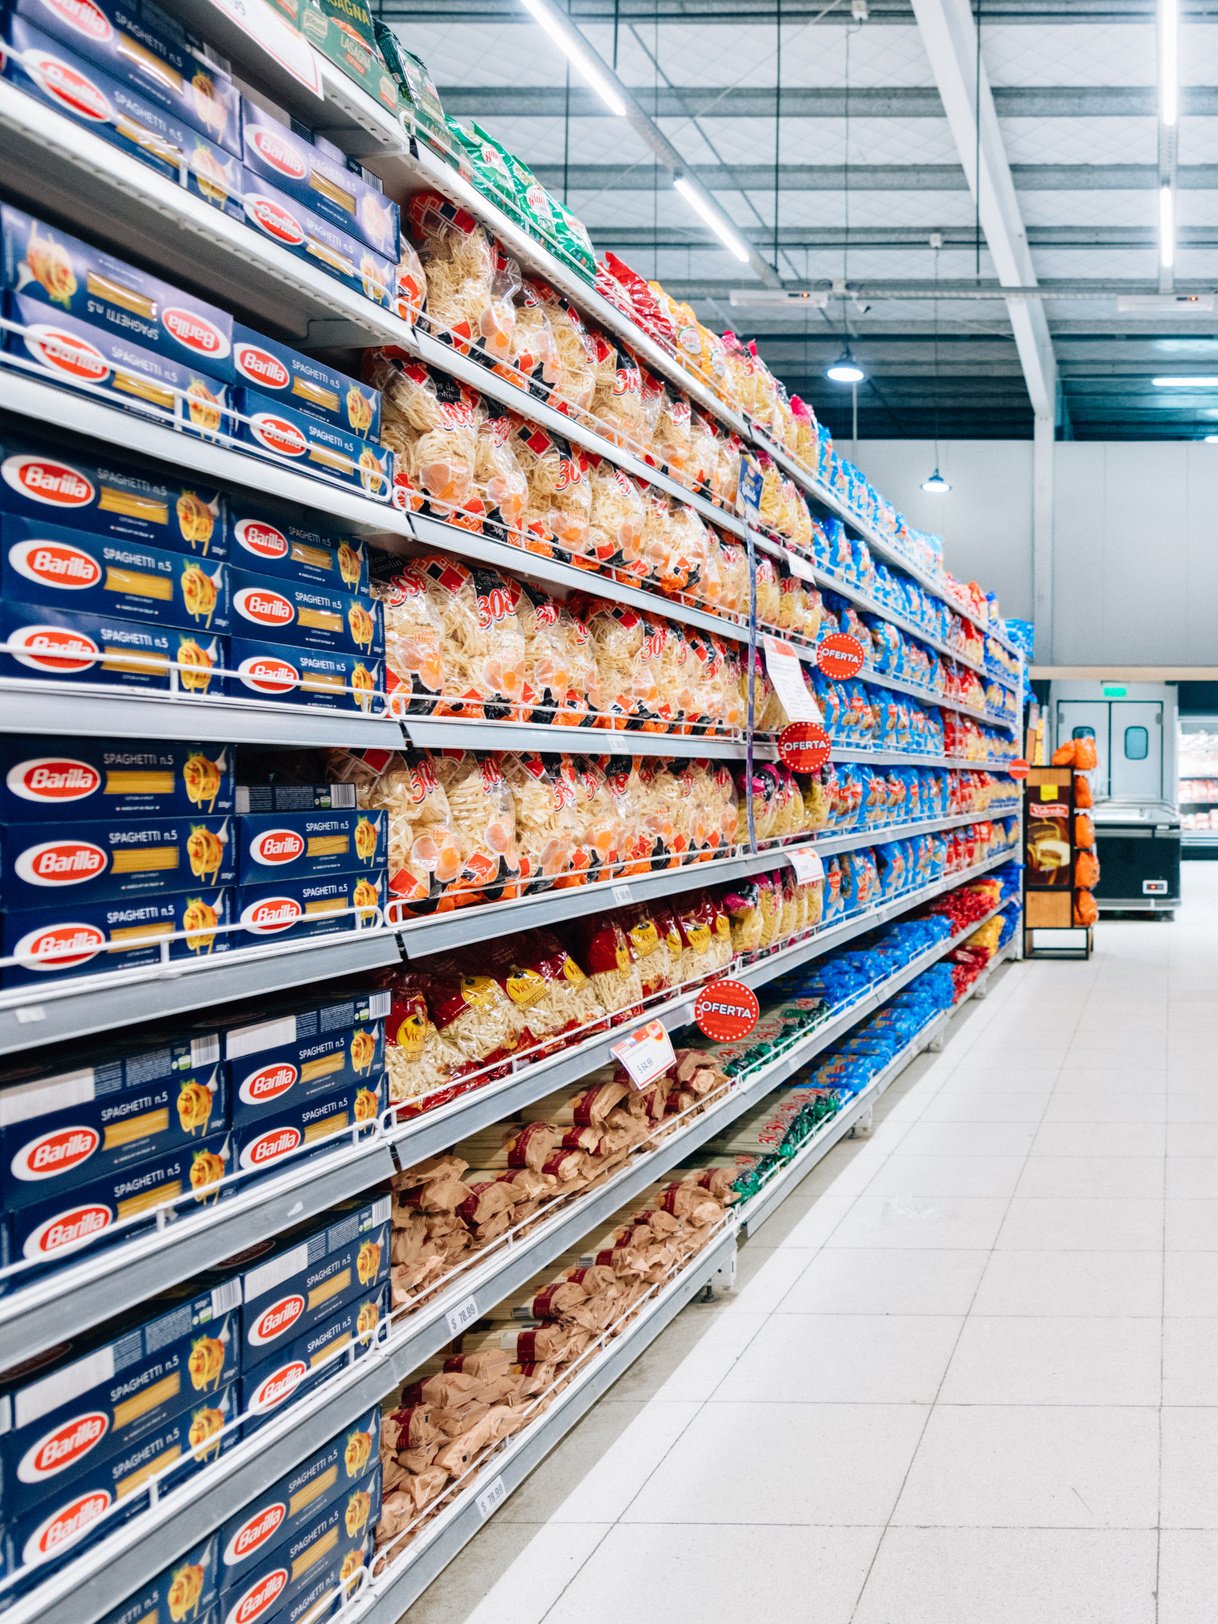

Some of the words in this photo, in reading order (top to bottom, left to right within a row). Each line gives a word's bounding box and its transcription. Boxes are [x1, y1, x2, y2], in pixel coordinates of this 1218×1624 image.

[169, 52, 183, 67] n.5
[168, 126, 183, 142] n.5
[259, 136, 302, 178] Barilla
[343, 241, 354, 254] n.5
[87, 300, 104, 313] n.5
[167, 313, 217, 348] Barilla
[111, 345, 163, 377] SPAGHETTI
[164, 370, 178, 383] n.5
[244, 353, 285, 384] Barilla
[292, 358, 329, 384] SPAGHETTI
[329, 376, 340, 389] n.5
[309, 426, 343, 448] SPAGHETTI
[344, 440, 354, 452] n.5
[24, 465, 87, 499] Barilla
[97, 468, 151, 493] SPAGHETTI
[152, 485, 168, 497] n.5
[249, 531, 285, 552] Barilla
[288, 526, 322, 545] SPAGHETTI
[322, 536, 332, 547] n.5
[32, 550, 95, 581] Barilla
[103, 548, 156, 570] SPAGHETTI
[158, 560, 172, 573] n.5
[249, 598, 290, 620] Barilla
[294, 591, 331, 607] SPAGHETTI
[332, 598, 343, 609] n.5
[101, 628, 152, 646] SPAGHETTI
[154, 637, 169, 649] n.5
[300, 657, 334, 671] SPAGHETTI
[335, 661, 346, 672] n.5
[821, 648, 859, 664] OFERTA
[253, 665, 295, 687] Barilla
[783, 740, 827, 751] OFERTA
[103, 753, 157, 765] SPAGHETTI
[159, 753, 174, 765] n.5
[30, 771, 93, 789] Barilla
[109, 831, 161, 844] SPAGHETTI
[163, 830, 178, 841] n.5
[306, 821, 339, 832] SPAGHETTI
[340, 820, 349, 830] n.5
[263, 836, 300, 856] Barilla
[38, 852, 100, 875] Barilla
[302, 886, 337, 898] SPAGHETTI
[338, 883, 348, 893] n.5
[107, 907, 159, 924] SPAGHETTI
[160, 905, 175, 918] n.5
[257, 905, 299, 923] Barilla
[701, 1001, 752, 1019] OFERTA
[299, 1041, 334, 1060] SPAGHETTI
[334, 1038, 345, 1049] n.5
[252, 1073, 293, 1095] Barilla
[101, 1096, 152, 1121] SPAGHETTI
[154, 1091, 169, 1105] n.5
[302, 1103, 337, 1122] SPAGHETTI
[338, 1097, 348, 1109] n.5
[33, 1137, 94, 1168] Barilla
[254, 1135, 297, 1161] Barilla
[113, 1170, 165, 1197] SPAGHETTI
[166, 1163, 181, 1177] n.5
[47, 1209, 107, 1245] Barilla
[306, 1262, 341, 1287] SPAGHETTI
[341, 1254, 351, 1266] n.5
[261, 1302, 300, 1334] Barilla
[451, 1317, 458, 1330] $
[459, 1304, 476, 1325] 78.99
[307, 1325, 342, 1352] SPAGHETTI
[341, 1317, 352, 1328] n.5
[111, 1364, 164, 1402] SPAGHETTI
[164, 1355, 180, 1370] n.5
[42, 1418, 105, 1461] Barilla
[112, 1437, 165, 1479] SPAGHETTI
[165, 1428, 181, 1443] n.5
[288, 1458, 326, 1493] SPAGHETTI
[326, 1450, 339, 1462] n.5
[487, 1483, 504, 1505] 78.99
[49, 1495, 108, 1548] Barilla
[238, 1509, 283, 1549] Barilla
[290, 1520, 326, 1558] SPAGHETTI
[327, 1511, 339, 1524] n.5
